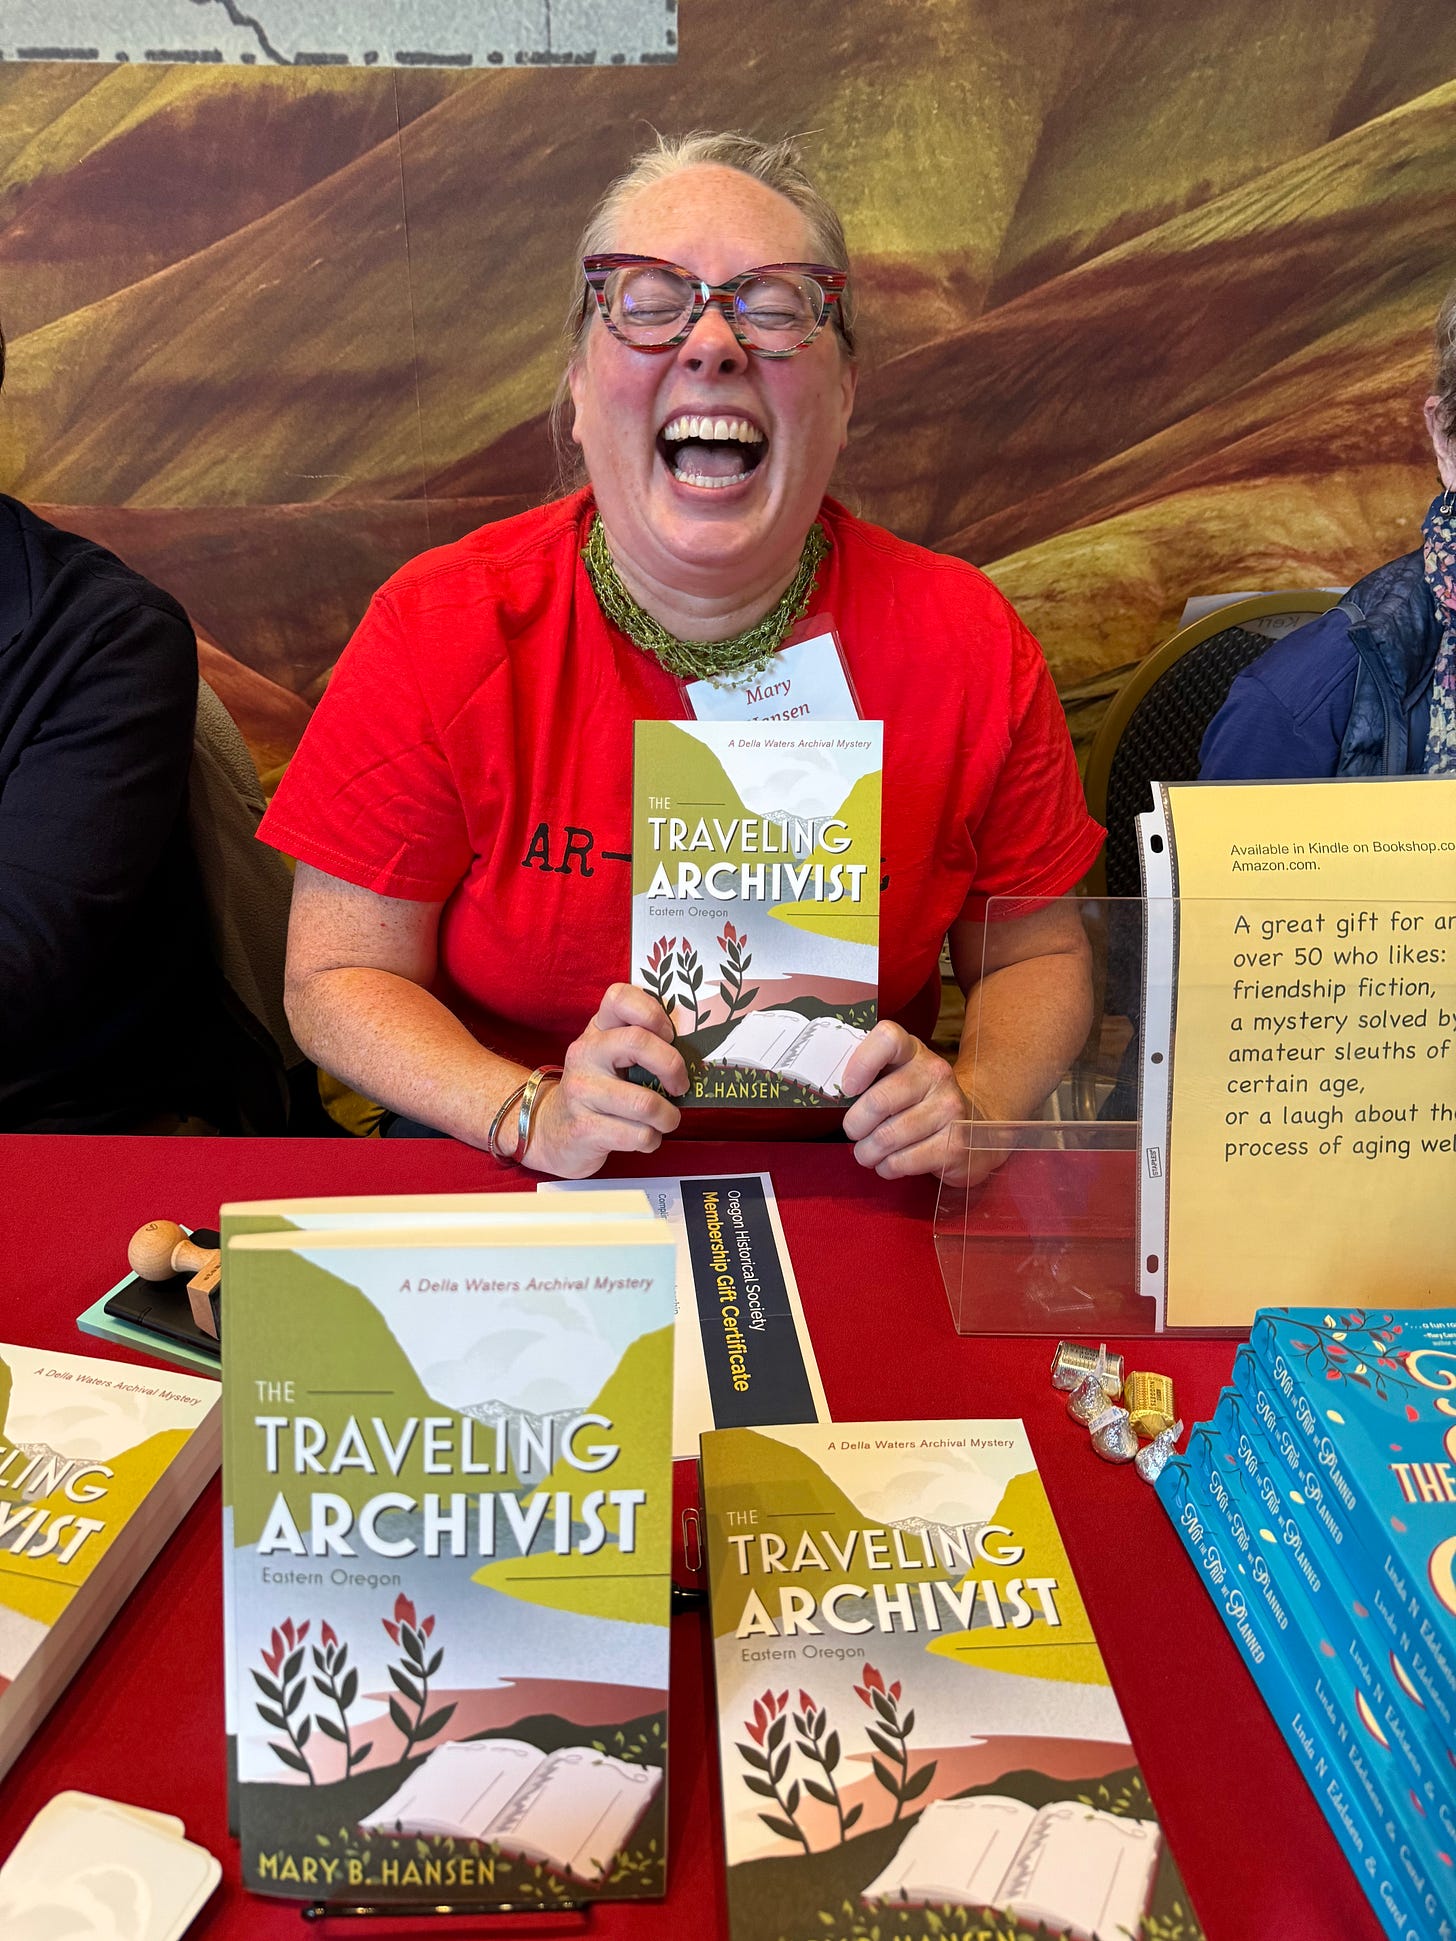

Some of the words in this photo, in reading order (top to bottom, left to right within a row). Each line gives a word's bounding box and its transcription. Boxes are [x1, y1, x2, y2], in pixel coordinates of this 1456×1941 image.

[745, 679, 792, 705] Mary
[728, 739, 735, 748] A
[738, 739, 762, 748] Della
[764, 739, 795, 748] Waters
[798, 739, 834, 748] Archival
[836, 739, 872, 750] Mystery
[648, 796, 671, 810] THE
[648, 817, 853, 855] TRAVELING
[1230, 844, 1289, 856] Available
[1293, 843, 1305, 854] in
[1309, 842, 1349, 854] Kindle
[1353, 843, 1369, 854] on
[1232, 860, 1321, 872] Amazon.com.
[647, 860, 867, 903] ARCHIVIST
[649, 905, 684, 917] Eastern
[688, 905, 728, 919] Oregon
[1234, 915, 1250, 934] A
[1261, 913, 1325, 940] great
[1336, 911, 1379, 939] gift
[1390, 910, 1424, 931] for
[1233, 952, 1283, 968] over
[1294, 947, 1322, 966] 50
[1334, 946, 1378, 965] who
[1389, 944, 1446, 965] likes:
[1233, 979, 1346, 1004] friendship
[1358, 977, 1436, 999] fiction,
[1230, 1017, 1243, 1031] a
[1254, 1011, 1348, 1036] mystery
[1358, 1008, 1427, 1029] solved
[1228, 1043, 1325, 1062] amateur
[1334, 1041, 1416, 1061] sleuths
[1426, 1039, 1451, 1059] of
[714, 1081, 780, 1099] HANSEN
[1227, 1074, 1308, 1093] certain
[1319, 1078, 1365, 1098] age,
[1225, 1110, 1249, 1125] or
[1259, 1110, 1271, 1125] a
[1283, 1105, 1343, 1130] laugh
[1354, 1103, 1418, 1123] about
[1225, 1140, 1308, 1162] process
[1319, 1135, 1343, 1155] of
[1352, 1135, 1410, 1160] aging
[727, 1190, 744, 1230] Oregon
[702, 1191, 731, 1273] Membership
[734, 1230, 755, 1286] Historical
[400, 1278, 413, 1292] A
[418, 1277, 460, 1292] Della
[465, 1276, 521, 1292] Waters
[525, 1276, 591, 1291] Archival
[594, 1277, 654, 1292] Mystery
[717, 1274, 737, 1304] Gift
[745, 1285, 766, 1332] Society
[721, 1305, 752, 1393] Certificate
[33, 1367, 44, 1375] A
[45, 1368, 73, 1381] Della
[76, 1374, 113, 1388] Waters
[114, 1381, 157, 1396] Archival
[159, 1390, 202, 1406] Mystery
[255, 1380, 296, 1403] THE
[255, 1413, 621, 1478] TRAVELING
[827, 1440, 837, 1451] A
[841, 1439, 871, 1451] Della
[874, 1439, 916, 1450] Waters
[920, 1438, 967, 1450] Archival
[970, 1437, 1015, 1451] Mystery
[256, 1490, 647, 1558] ARCHIVIST
[727, 1509, 759, 1525] THE
[728, 1524, 1025, 1576] TRAVELING
[261, 1567, 324, 1587] Eastern
[330, 1567, 402, 1592] Oregon
[735, 1578, 1063, 1640] ARCHIVIST
[741, 1645, 797, 1662] Eastern
[802, 1643, 865, 1661] Oregon
[258, 1849, 341, 1881] MARY
[347, 1853, 374, 1885] B.
[380, 1855, 496, 1887] HANSEN
